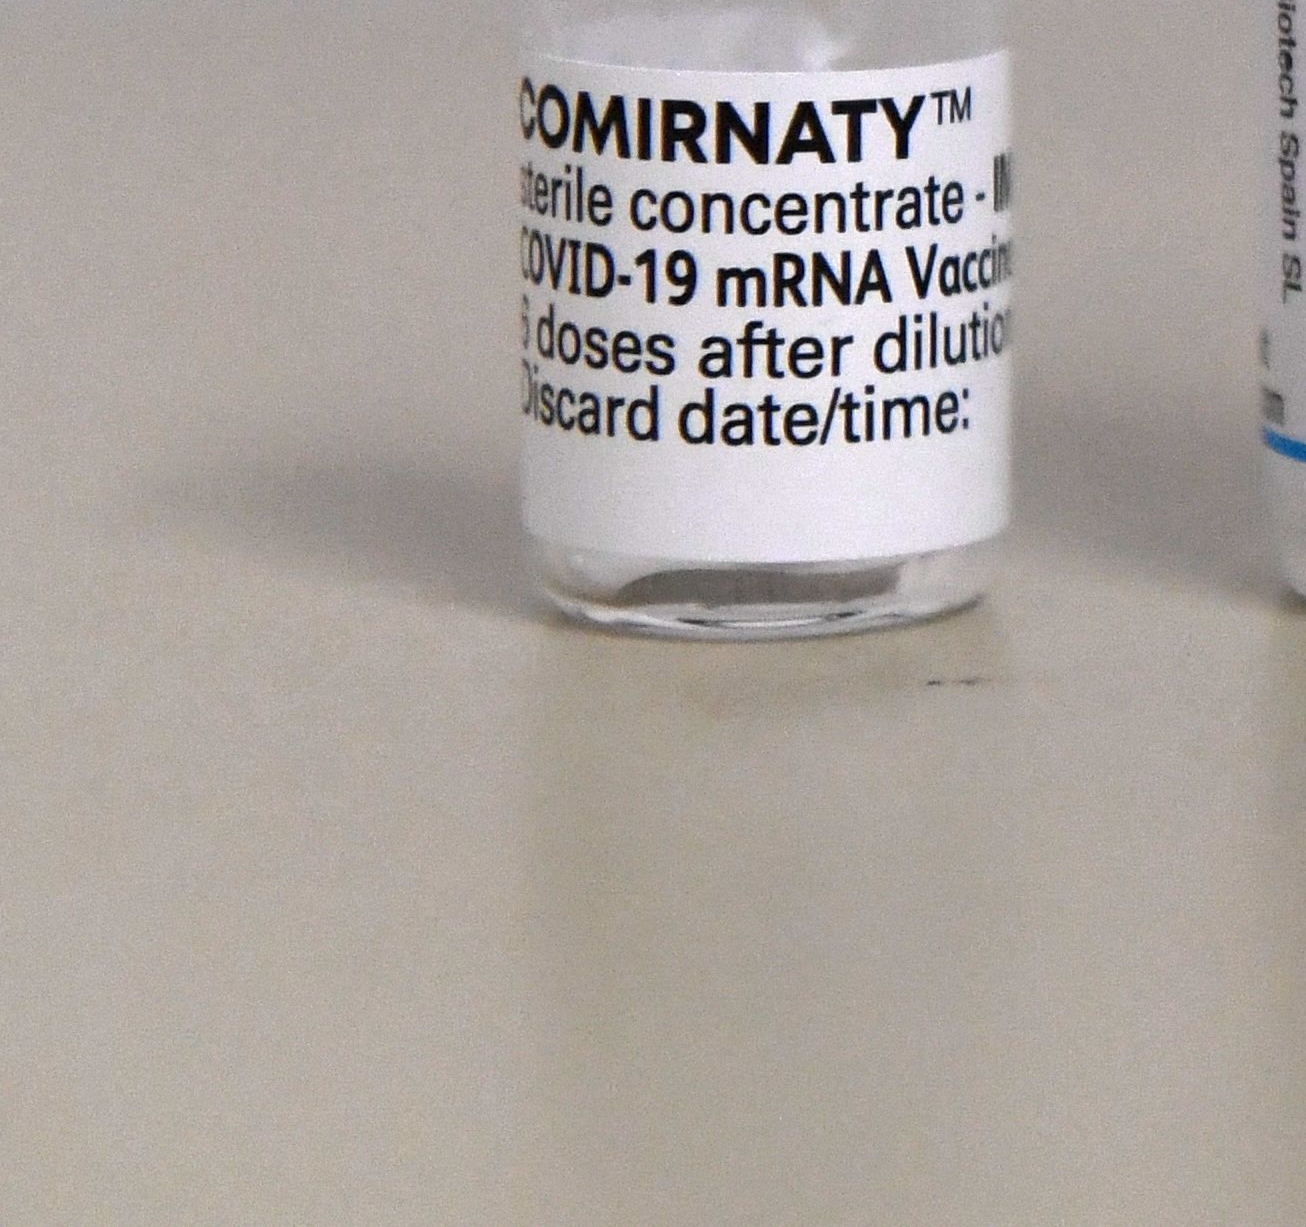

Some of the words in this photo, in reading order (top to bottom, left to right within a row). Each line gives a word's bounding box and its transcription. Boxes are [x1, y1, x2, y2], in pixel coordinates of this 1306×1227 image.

[629, 179, 965, 236] concentrate
[1278, 130, 1300, 240] Spain
[519, 224, 698, 306] COVID-19
[716, 248, 894, 308] mRNA
[536, 302, 677, 377] doses
[698, 321, 854, 379] after
[677, 387, 971, 447] date/time:
